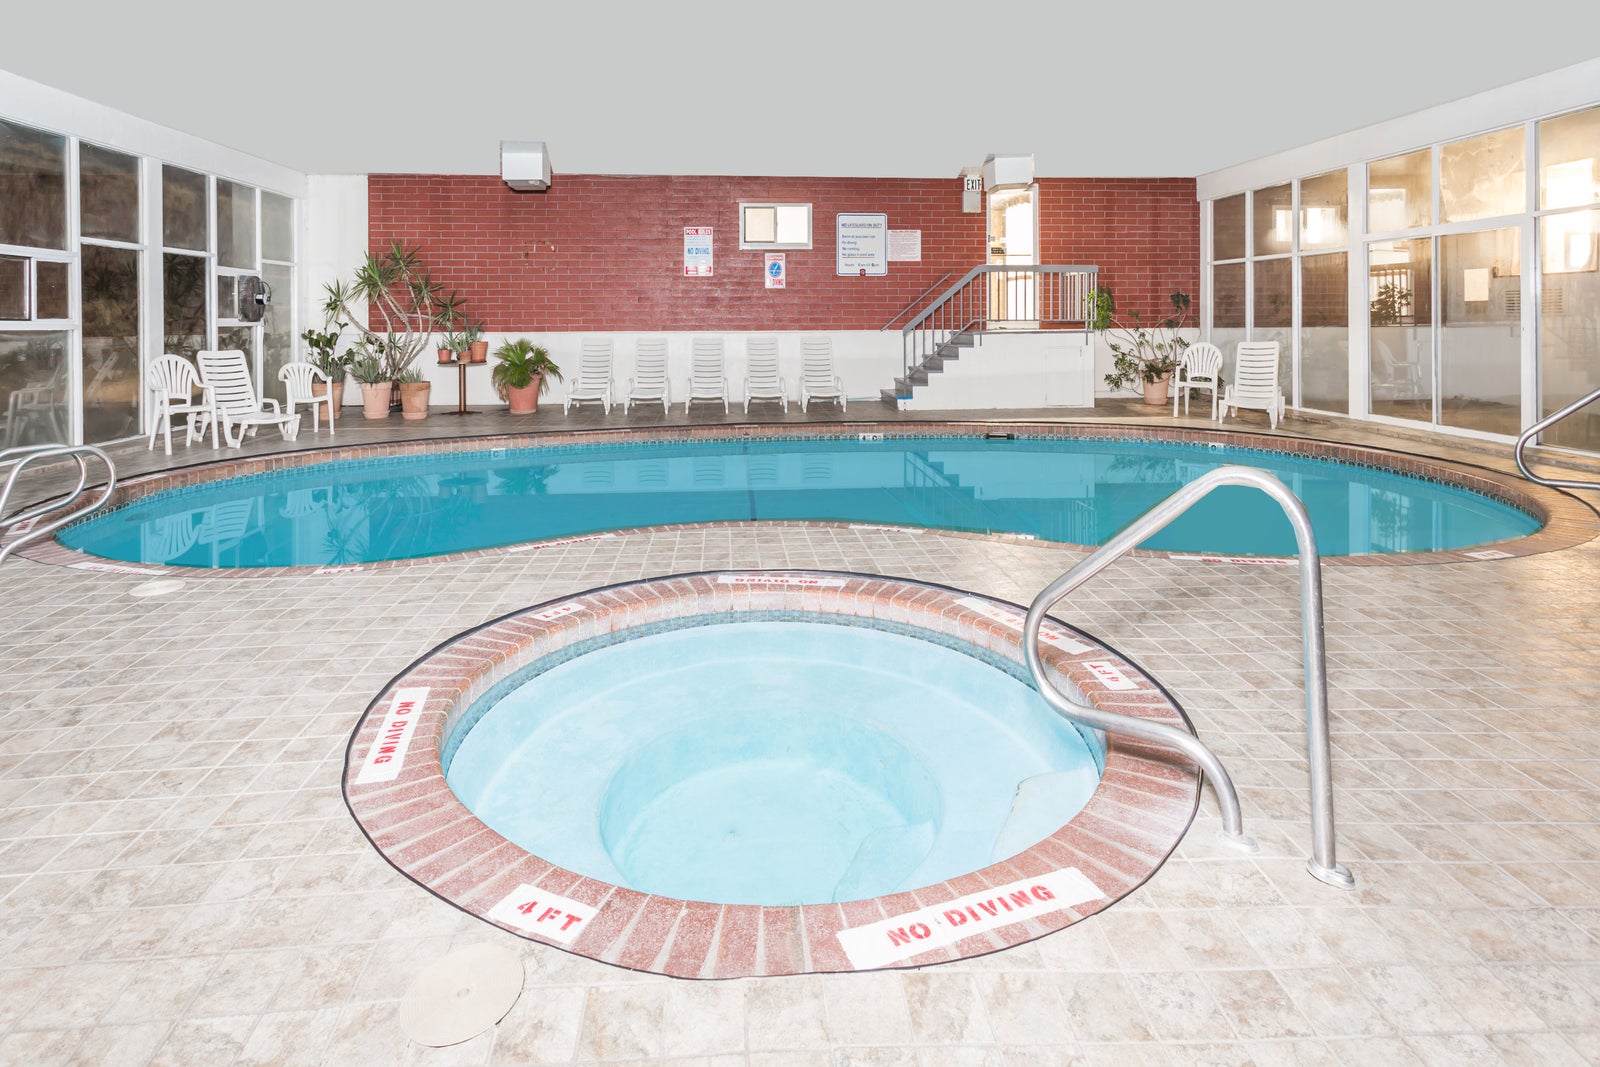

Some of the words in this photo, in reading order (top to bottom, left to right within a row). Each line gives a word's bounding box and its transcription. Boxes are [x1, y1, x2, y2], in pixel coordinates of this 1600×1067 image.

[966, 179, 981, 191] EXIT
[687, 247, 694, 255] NO
[395, 701, 416, 716] NO
[373, 720, 409, 765] DIVING
[517, 900, 583, 931] 4FT
[886, 921, 932, 947] NO
[942, 885, 1056, 928] DIVING
